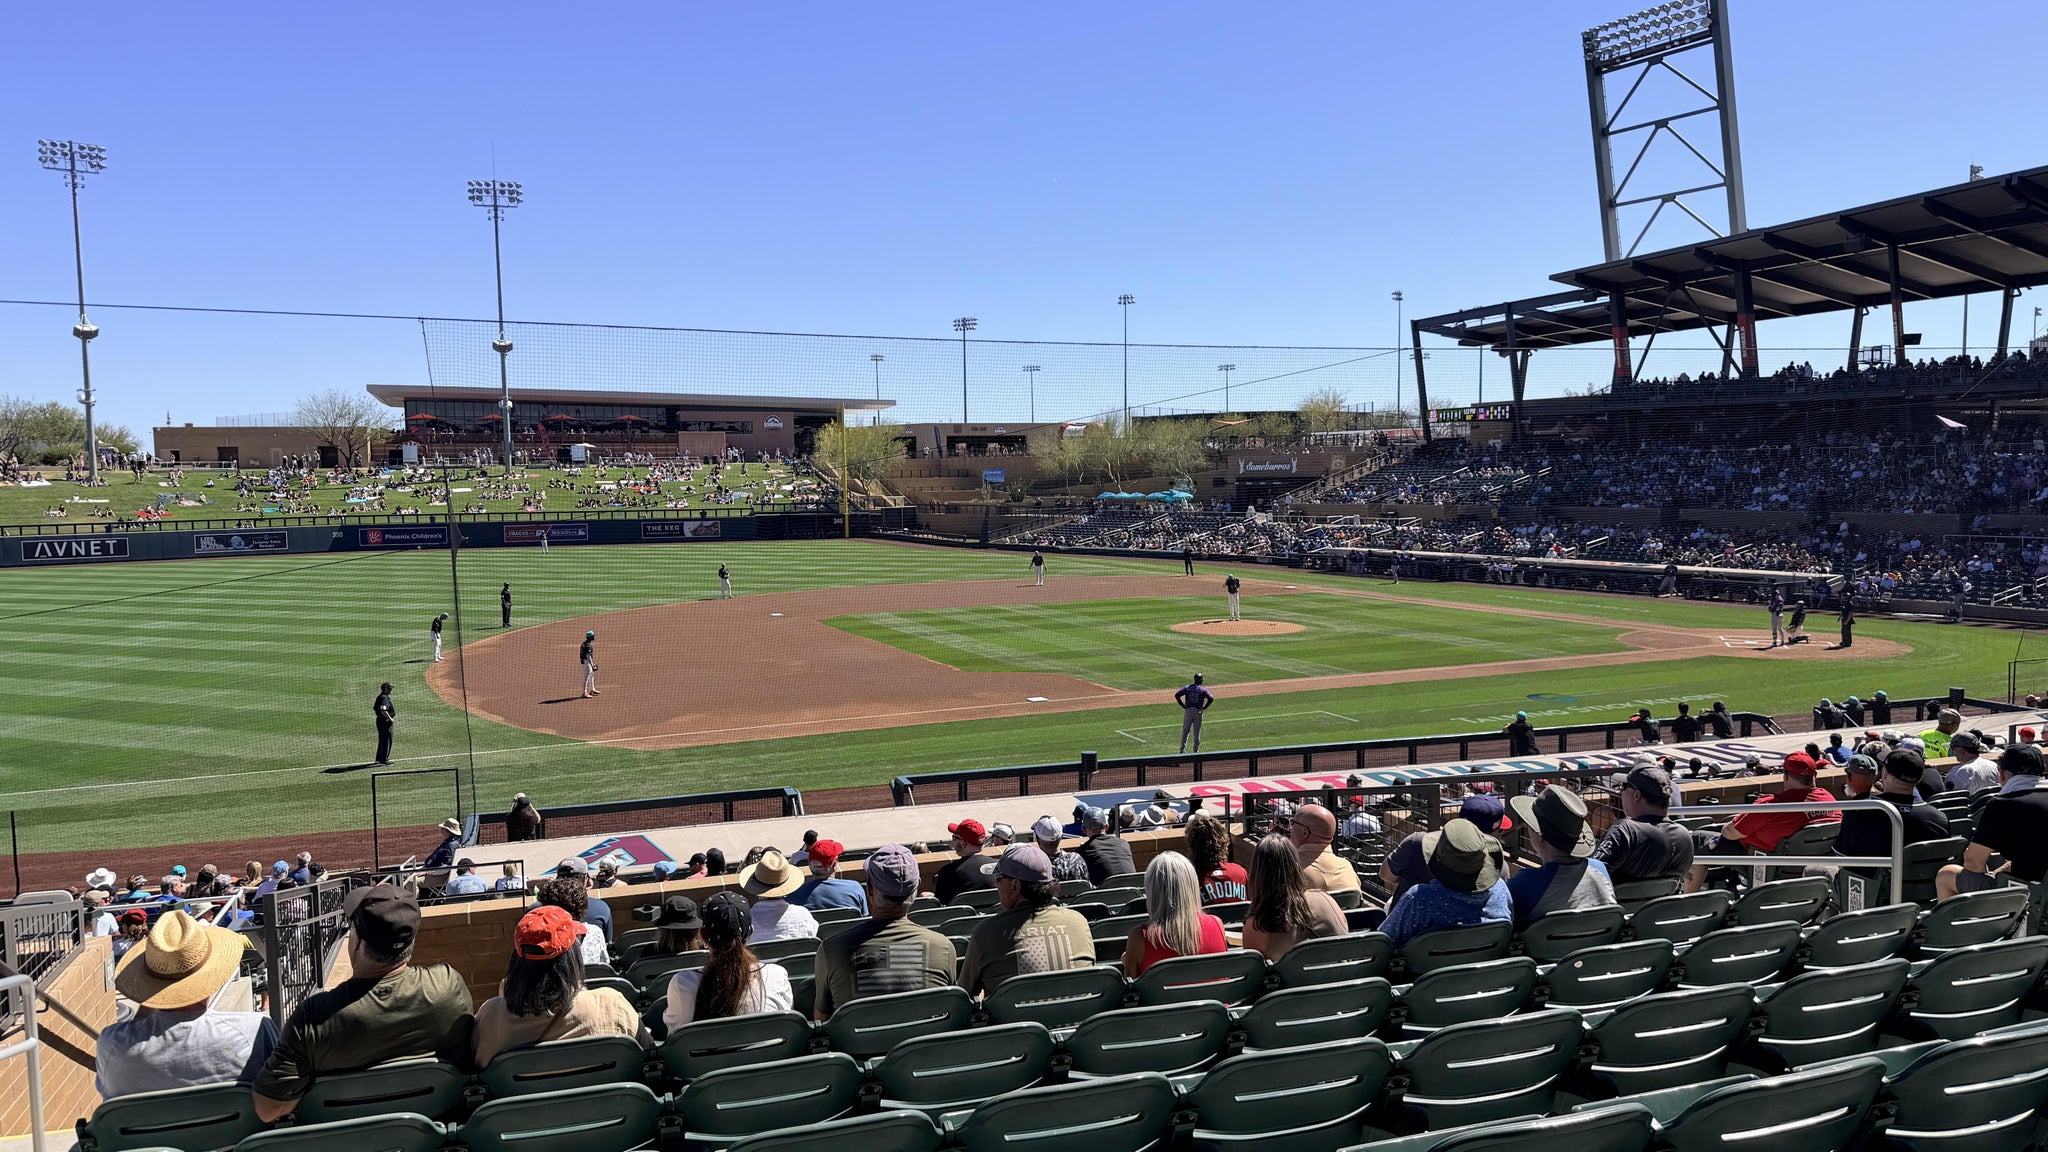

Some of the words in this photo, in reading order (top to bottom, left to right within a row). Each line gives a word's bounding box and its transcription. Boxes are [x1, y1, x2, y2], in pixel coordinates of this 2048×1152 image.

[34, 540, 117, 558] AVNET
[1200, 881, 1246, 903] ERDOMO
[1014, 925, 1066, 939] ARIAT
